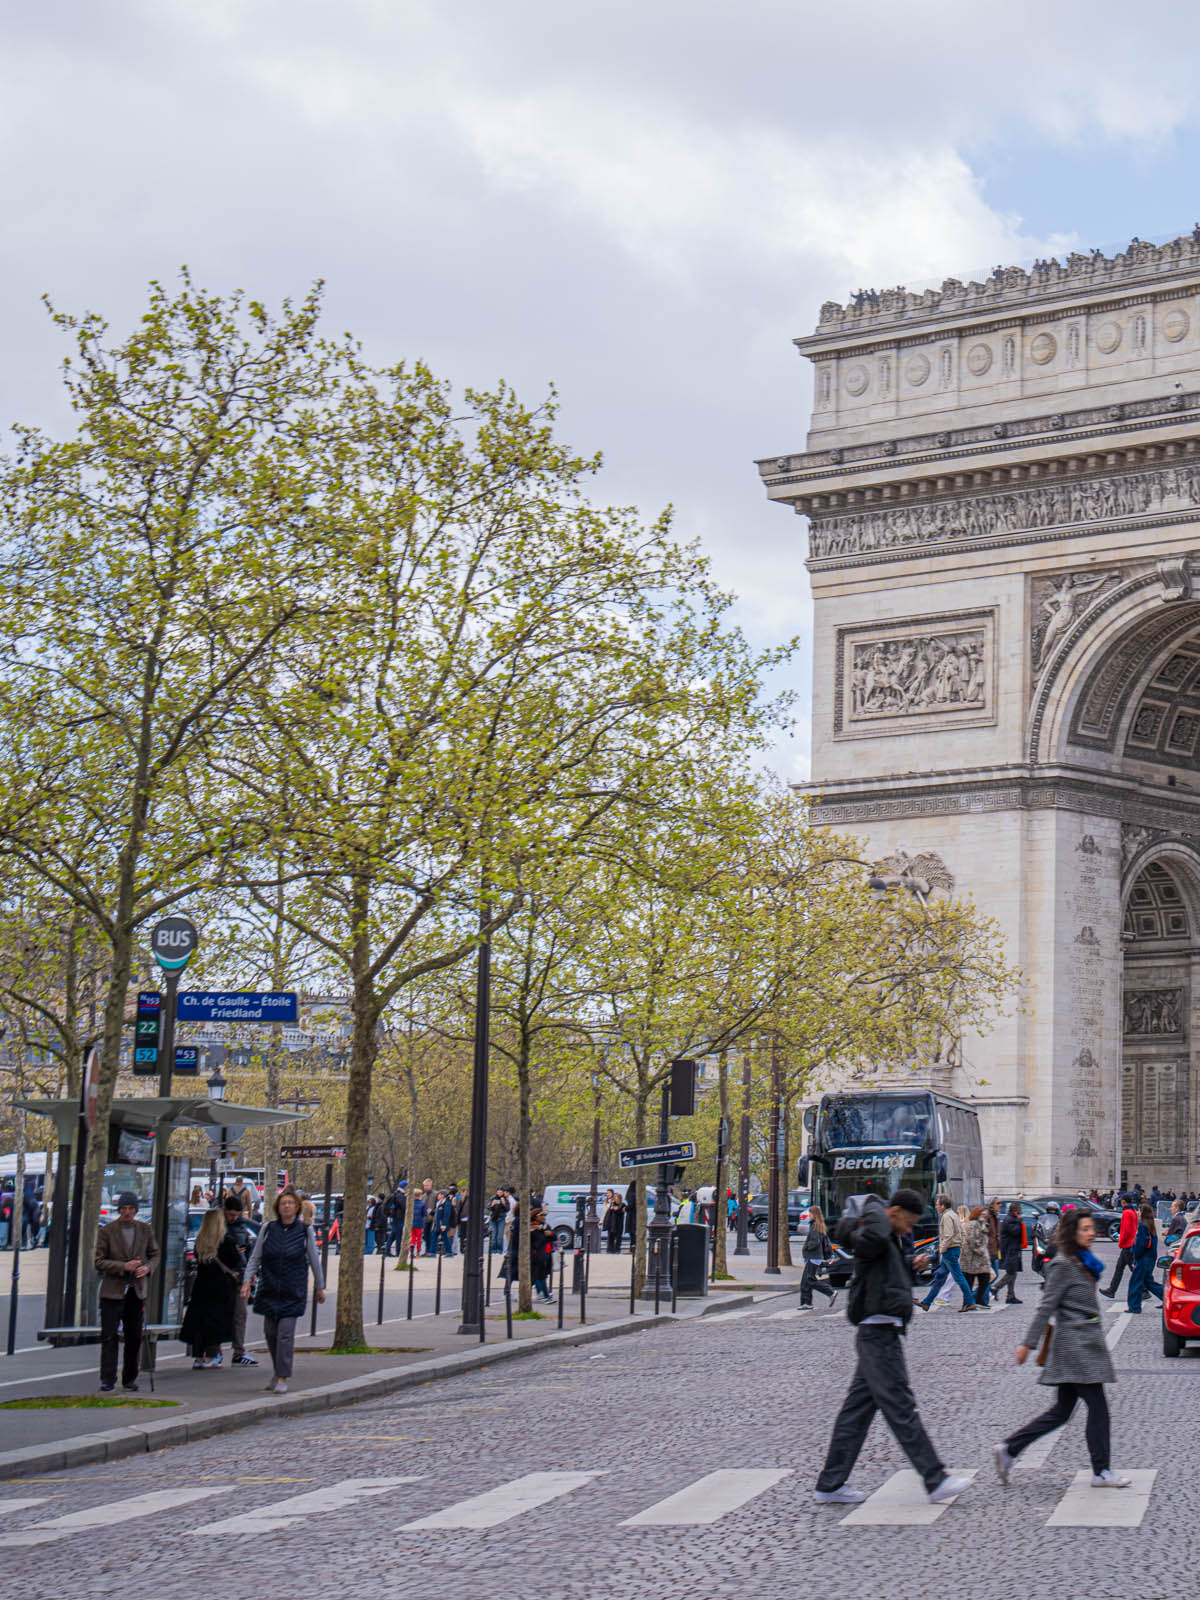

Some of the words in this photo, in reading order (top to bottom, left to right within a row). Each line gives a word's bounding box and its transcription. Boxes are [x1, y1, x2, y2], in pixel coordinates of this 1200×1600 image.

[157, 930, 191, 947] BUS
[183, 996, 200, 1006] Ch.
[201, 995, 215, 1006] de
[217, 995, 250, 1006] Gaulle
[261, 995, 291, 1006] Étoile
[210, 1008, 262, 1018] Friedland
[139, 1022, 157, 1033] 22
[138, 1050, 154, 1061] 52
[176, 1049, 196, 1059] N53
[834, 1154, 917, 1170] Berchtold
